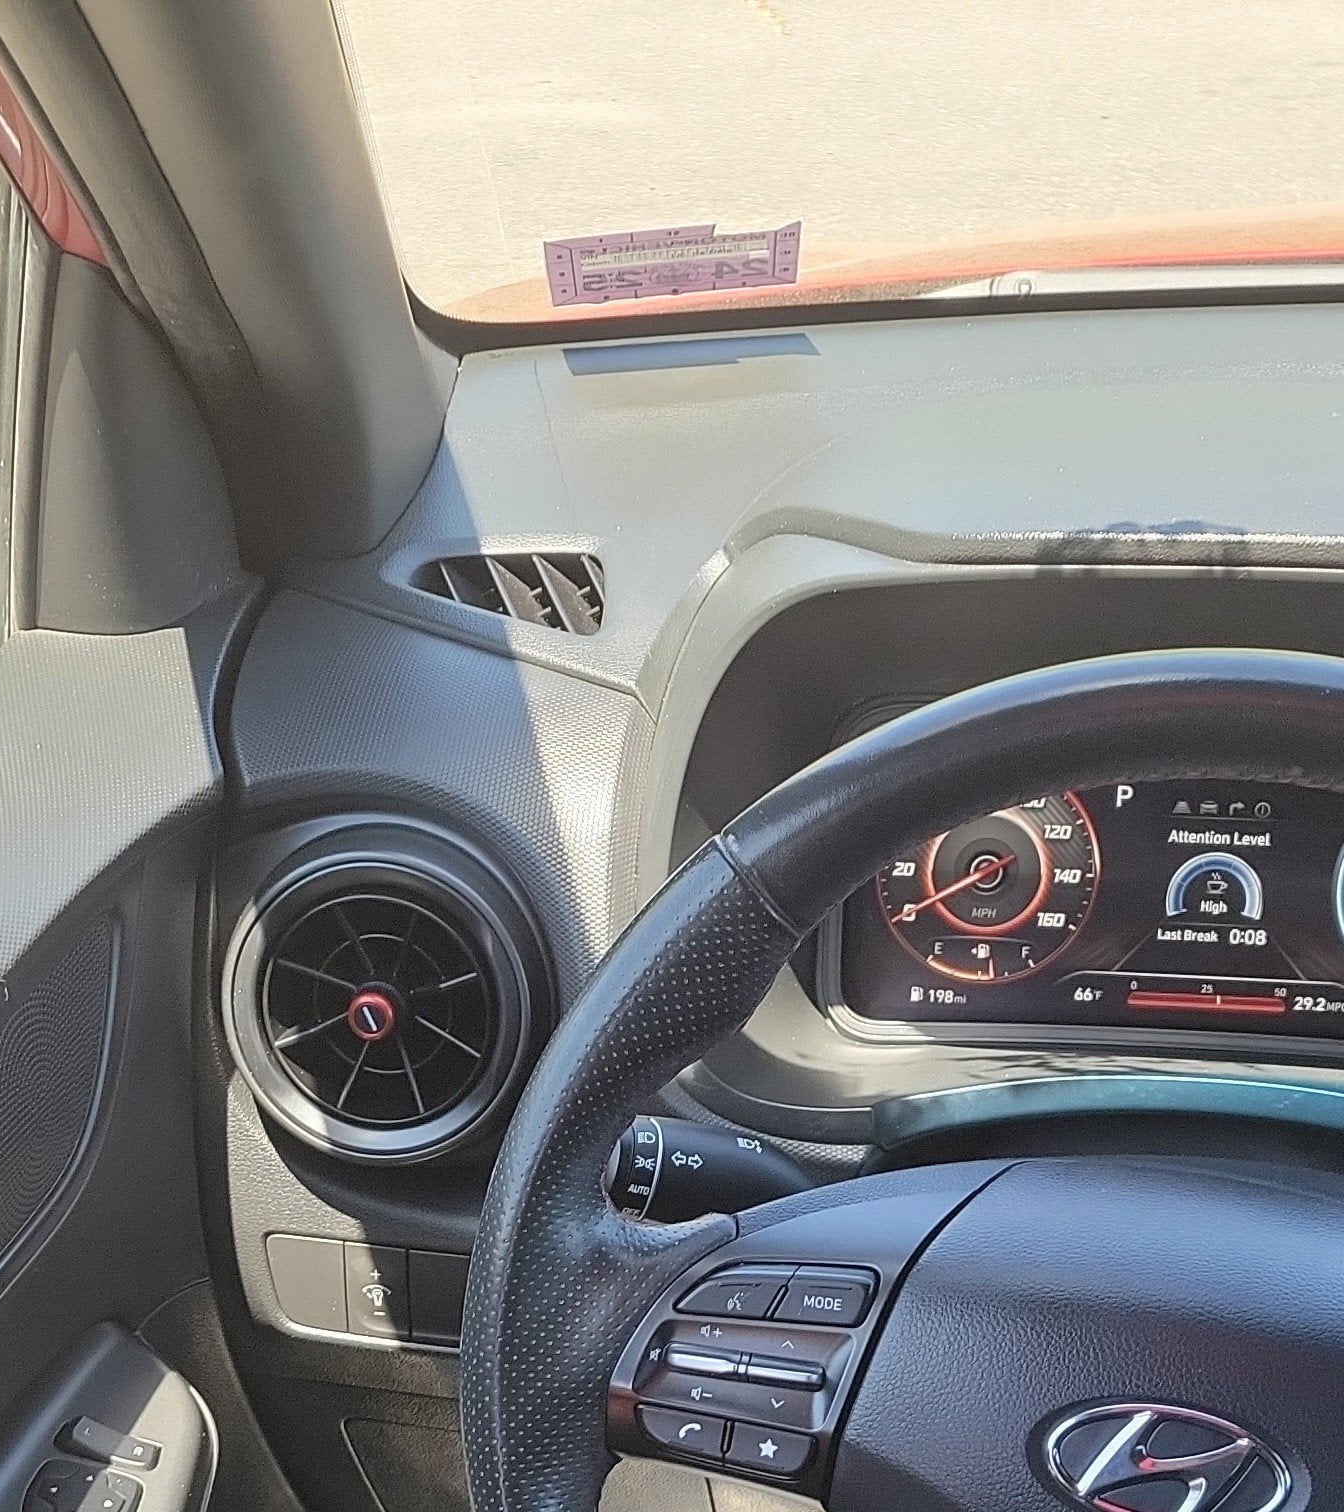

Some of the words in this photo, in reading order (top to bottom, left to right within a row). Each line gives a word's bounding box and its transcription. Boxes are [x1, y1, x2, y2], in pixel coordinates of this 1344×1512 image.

[1116, 785, 1133, 807] P
[1044, 825, 1072, 839] 120
[1168, 829, 1231, 846] Attention
[1234, 831, 1271, 847] Level
[892, 862, 916, 877] 20
[1053, 869, 1082, 884] 140
[971, 908, 997, 919] MPH
[1200, 901, 1228, 915] High
[1037, 912, 1066, 928] 160
[1157, 929, 1181, 941] Last
[1184, 930, 1218, 943] Break
[1229, 929, 1267, 946] 0:08
[934, 942, 943, 954] E
[1021, 946, 1031, 958] F
[1130, 980, 1138, 991] 0
[1201, 983, 1213, 994] 25
[1274, 987, 1287, 998] 50
[628, 1184, 650, 1195] AUTO
[804, 1296, 843, 1311] MODE
